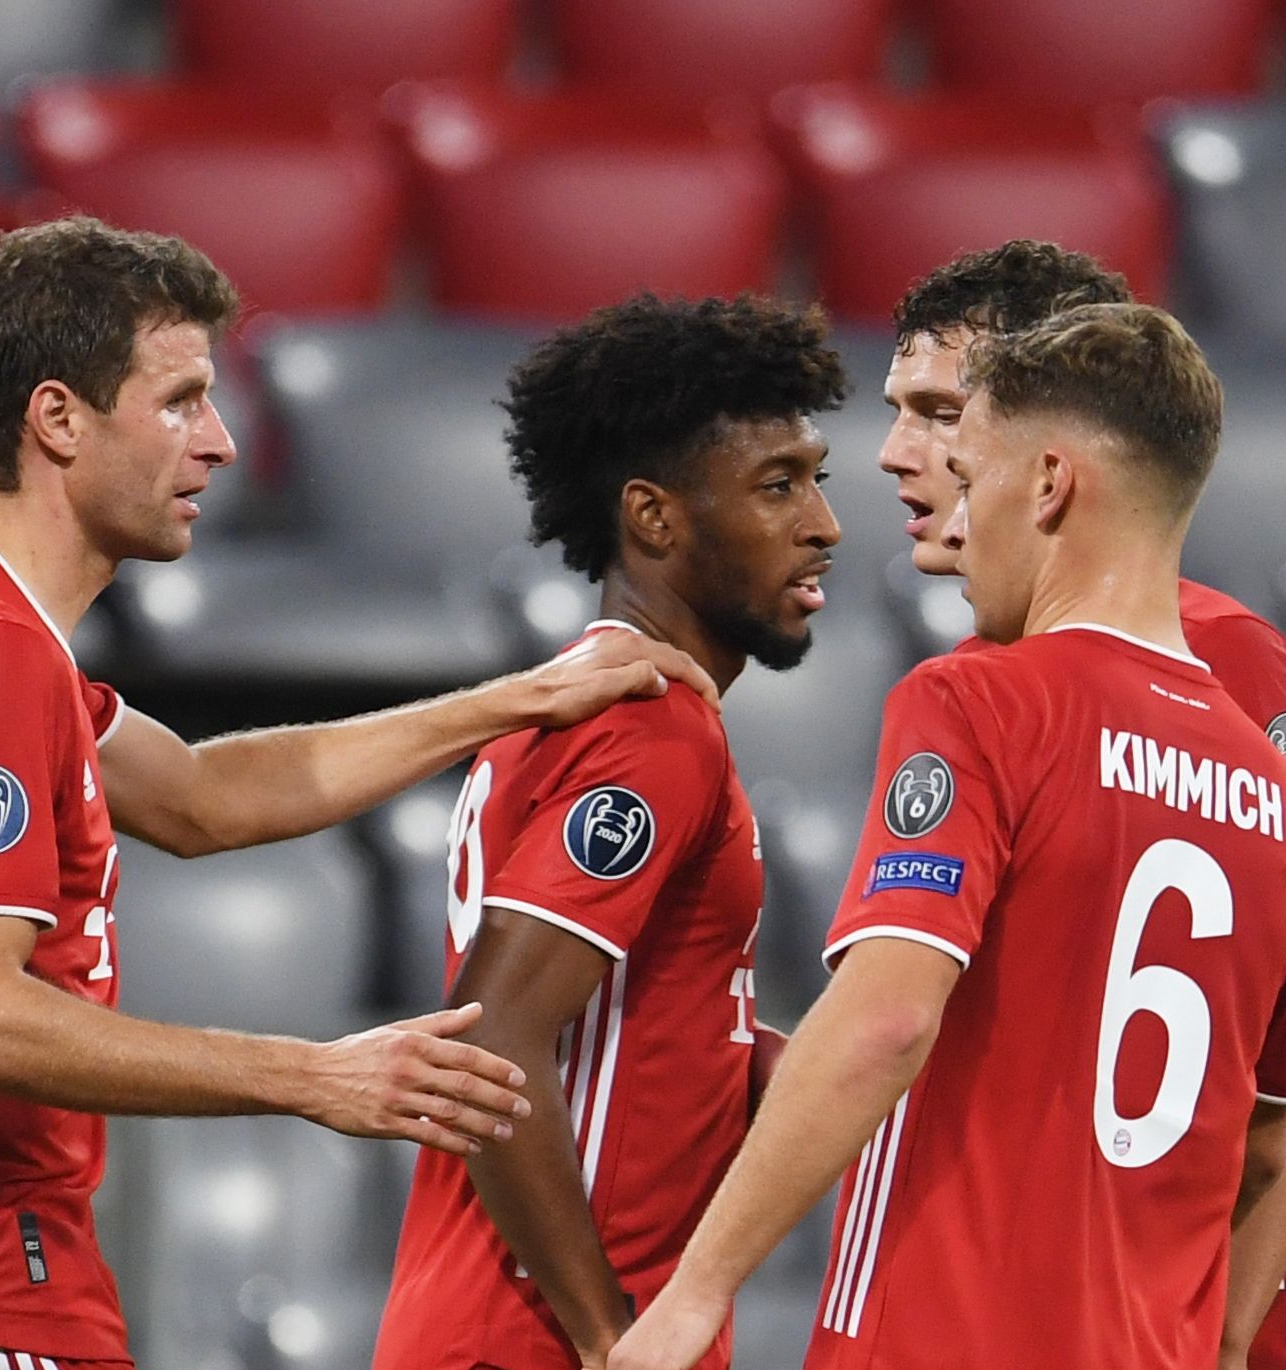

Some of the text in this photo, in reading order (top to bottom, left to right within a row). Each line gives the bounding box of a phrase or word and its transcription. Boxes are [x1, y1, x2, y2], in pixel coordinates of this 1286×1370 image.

[1100, 727, 1284, 842] KIMMICH
[909, 796, 926, 818] 6
[595, 825, 623, 844] 2020
[876, 861, 961, 885] RESPECT
[1093, 838, 1233, 1168] 6
